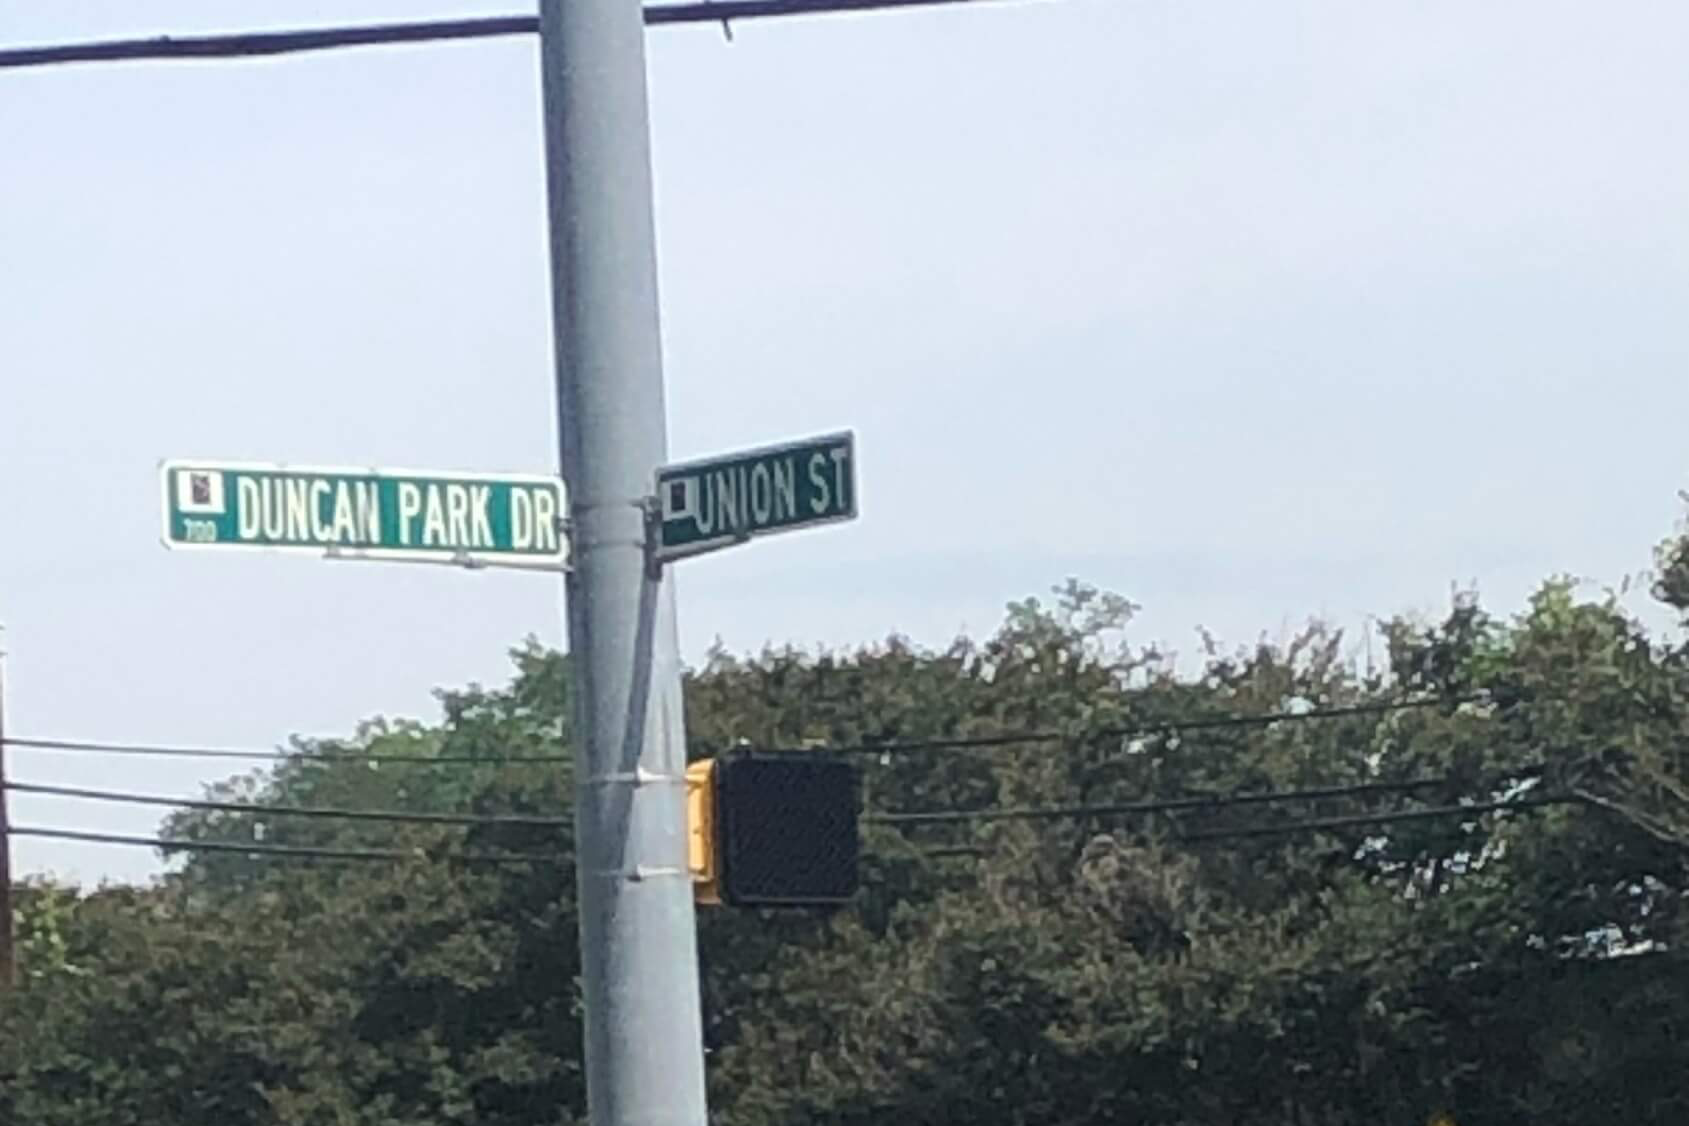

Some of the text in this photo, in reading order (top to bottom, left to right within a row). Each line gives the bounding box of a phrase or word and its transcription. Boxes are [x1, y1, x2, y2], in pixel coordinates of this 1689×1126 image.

[237, 476, 558, 550] DUNCAN PARK DR
[696, 447, 848, 534] UNION ST
